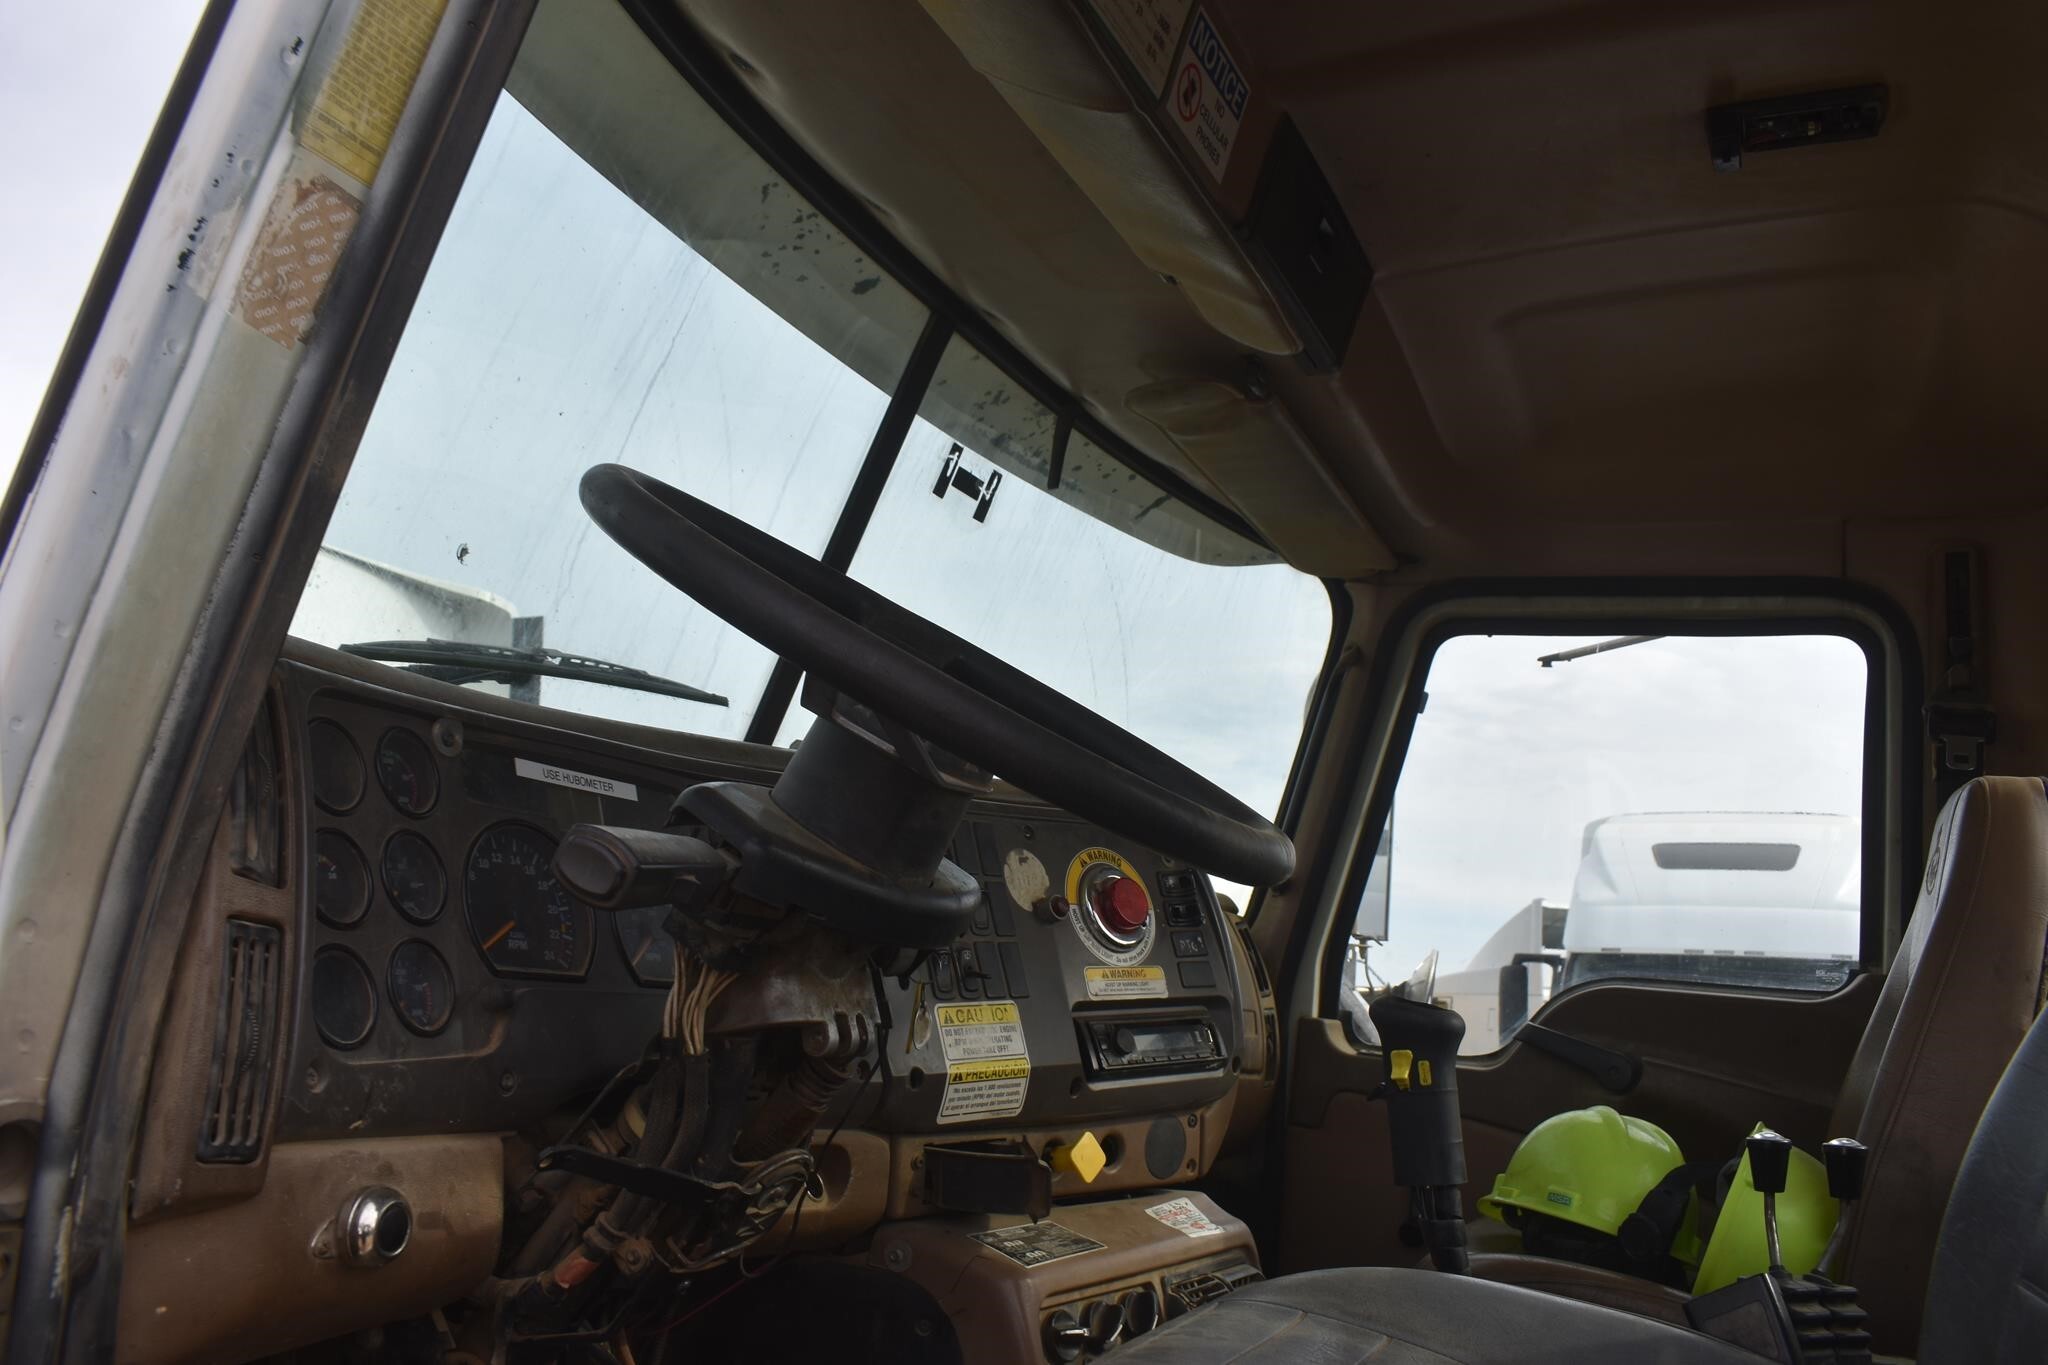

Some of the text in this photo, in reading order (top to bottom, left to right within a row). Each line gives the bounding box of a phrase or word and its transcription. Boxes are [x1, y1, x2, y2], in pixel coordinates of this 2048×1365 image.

[1192, 20, 1246, 114] NOTICE
[1214, 95, 1225, 118] NO
[1199, 103, 1229, 151] CELLULAR
[1195, 126, 1221, 166] PHONES
[300, 211, 352, 231] VOID VOID
[304, 235, 327, 249] VOID
[272, 244, 296, 257] VOID
[255, 296, 310, 319] VOID VOID
[542, 767, 614, 793] USE HUBOMETER
[478, 857, 490, 868] 10
[491, 853, 503, 863] 12
[510, 855, 521, 865] 14
[1086, 849, 1122, 868] WARNING
[537, 880, 549, 891] 18
[547, 904, 559, 915] 20
[549, 930, 560, 940] 22
[508, 940, 529, 951] RPM
[1110, 969, 1146, 979] WARNING
[956, 1007, 1010, 1023] CAUIO
